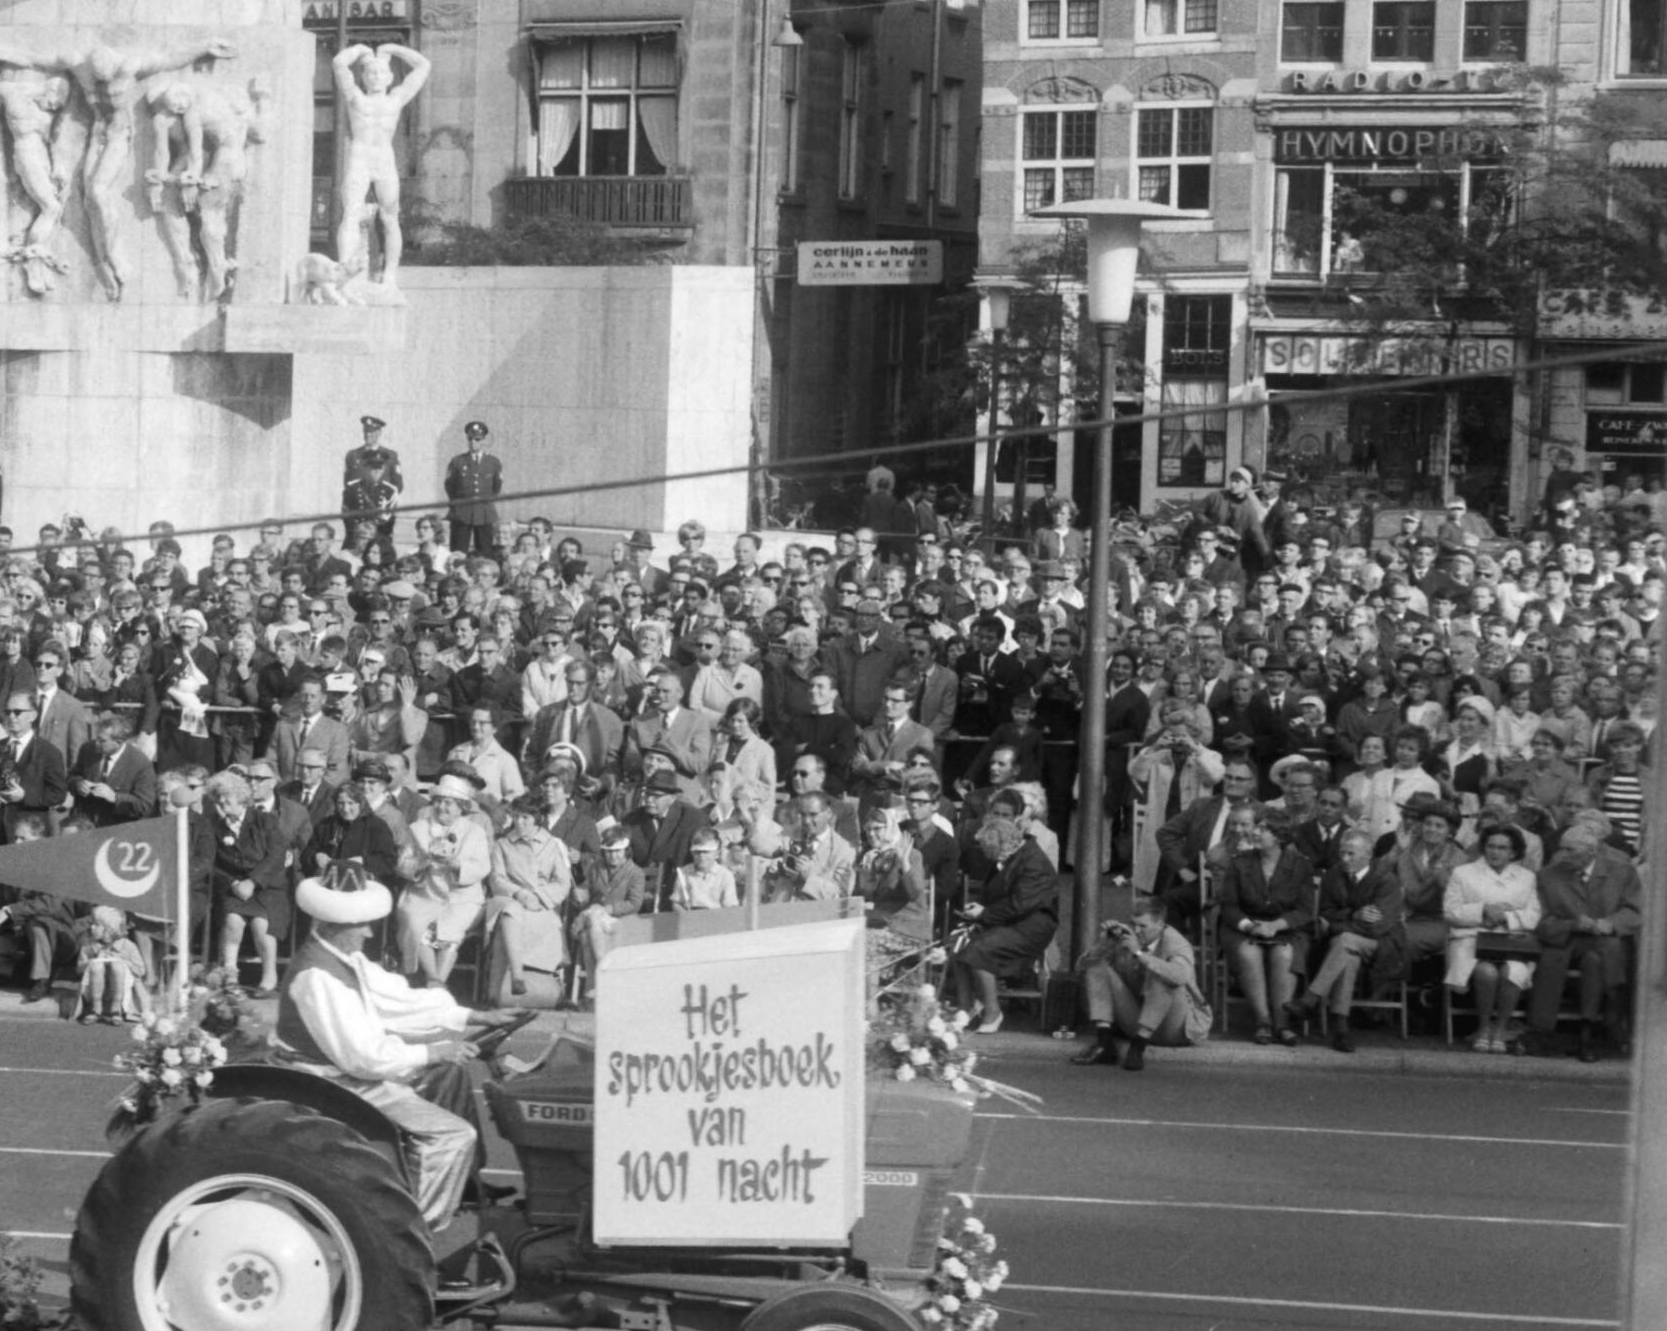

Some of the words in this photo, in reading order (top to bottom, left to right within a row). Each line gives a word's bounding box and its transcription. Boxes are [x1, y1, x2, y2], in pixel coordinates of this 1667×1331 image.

[117, 841, 152, 872] 22
[681, 984, 749, 1039] Het
[608, 1032, 841, 1107] sprookjesboek
[527, 1104, 587, 1122] FORD
[688, 1106, 746, 1147] van
[618, 1151, 689, 1202] 1001
[718, 1144, 830, 1204] nacht
[864, 1172, 913, 1184] 2000
